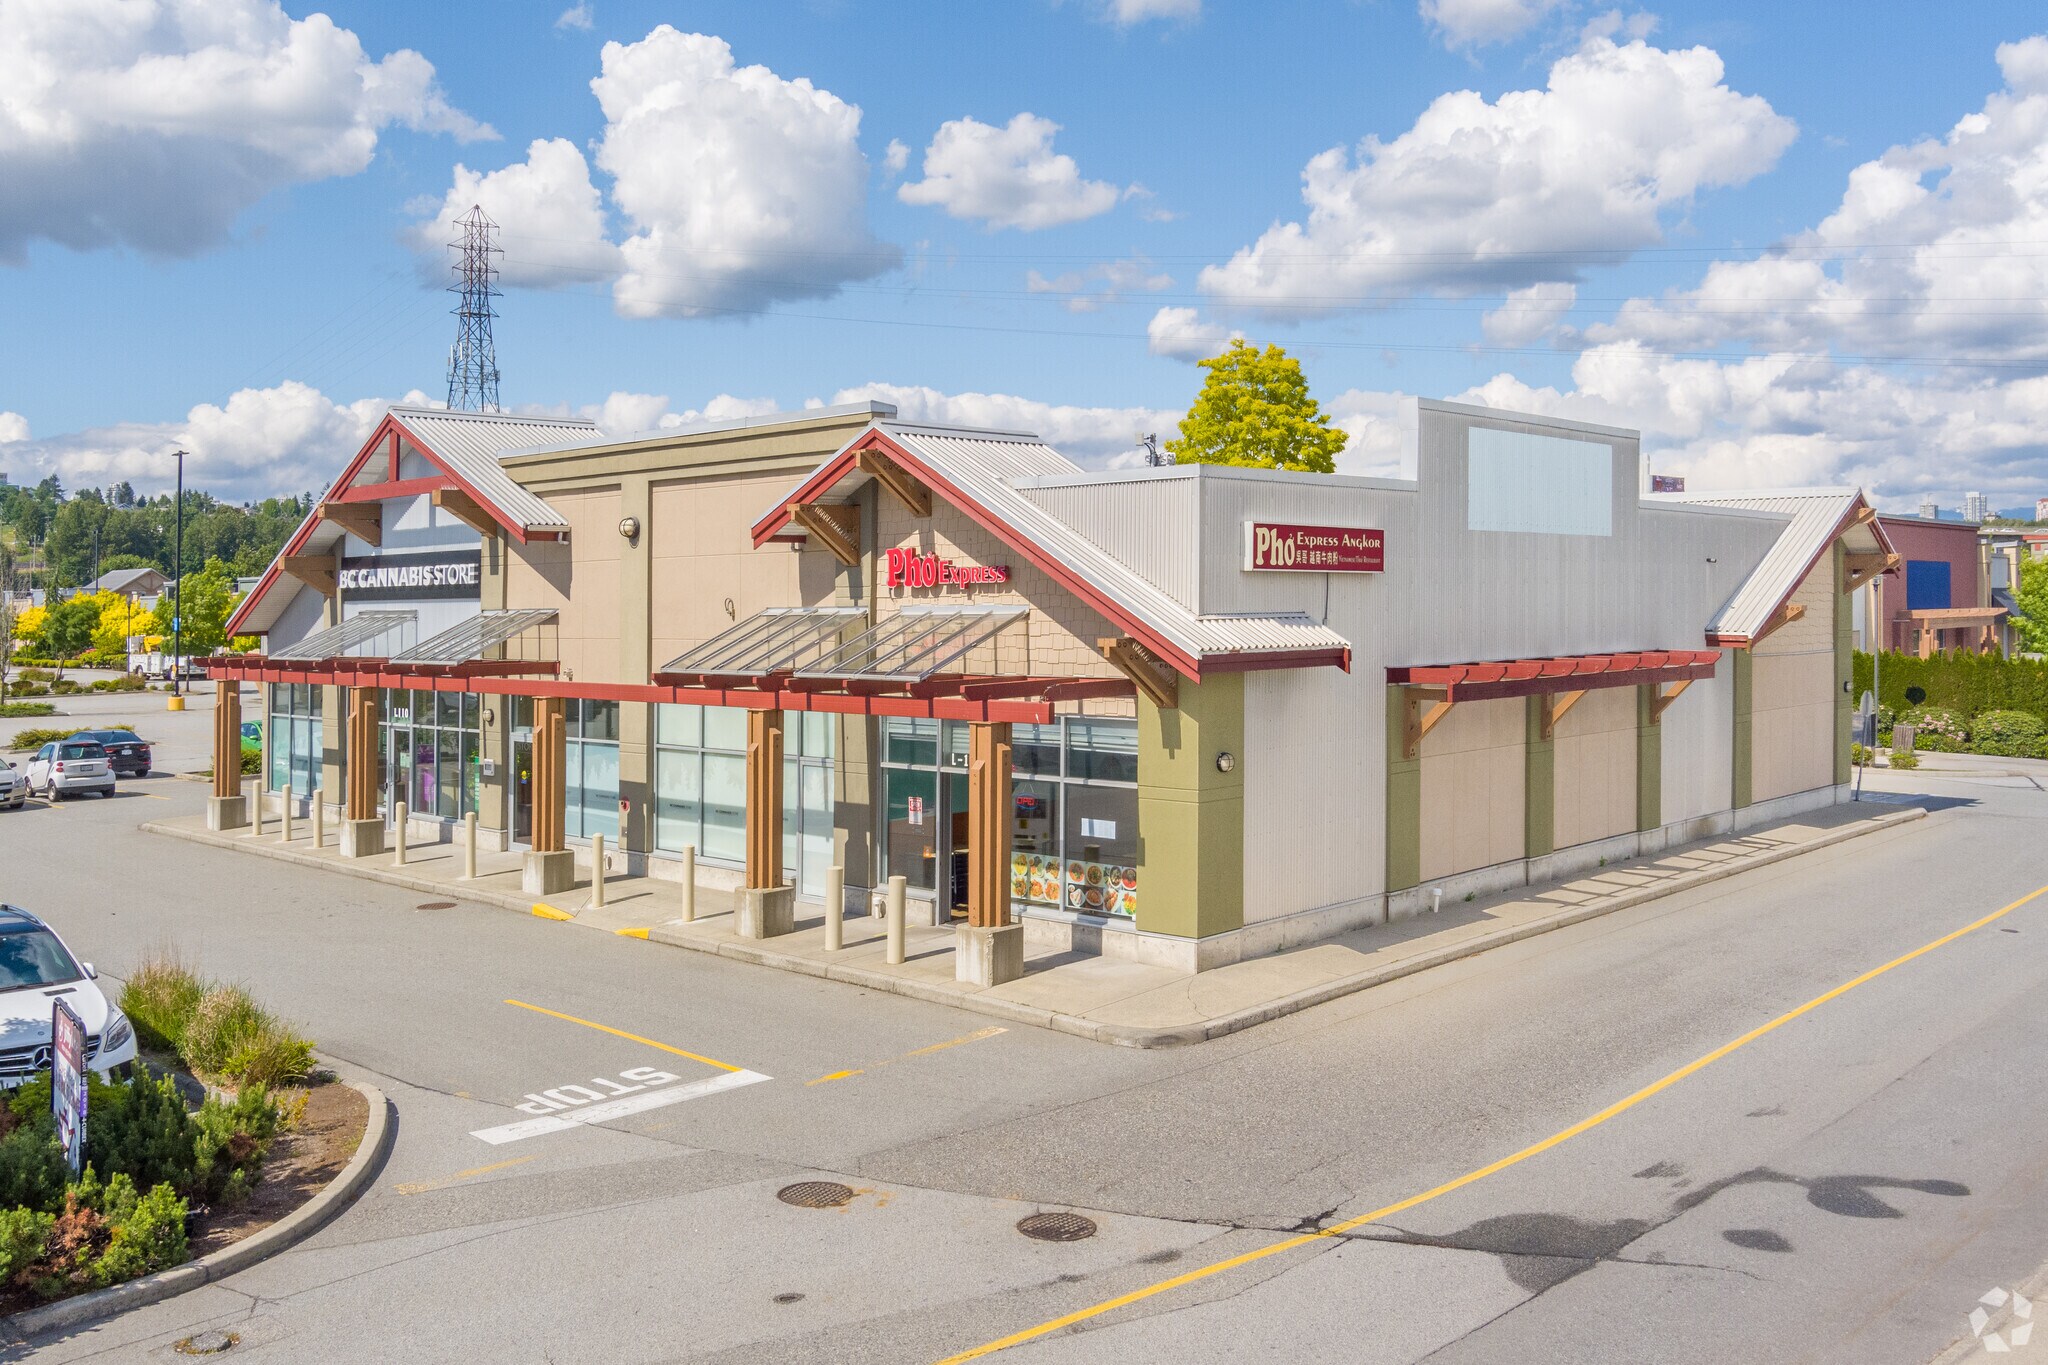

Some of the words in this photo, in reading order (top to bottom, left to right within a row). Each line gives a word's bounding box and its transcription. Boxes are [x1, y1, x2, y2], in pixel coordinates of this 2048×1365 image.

[339, 569, 358, 588] BC
[358, 567, 431, 588] CANNABIS
[433, 563, 479, 585] STORE
[514, 1066, 682, 1114] STOP
